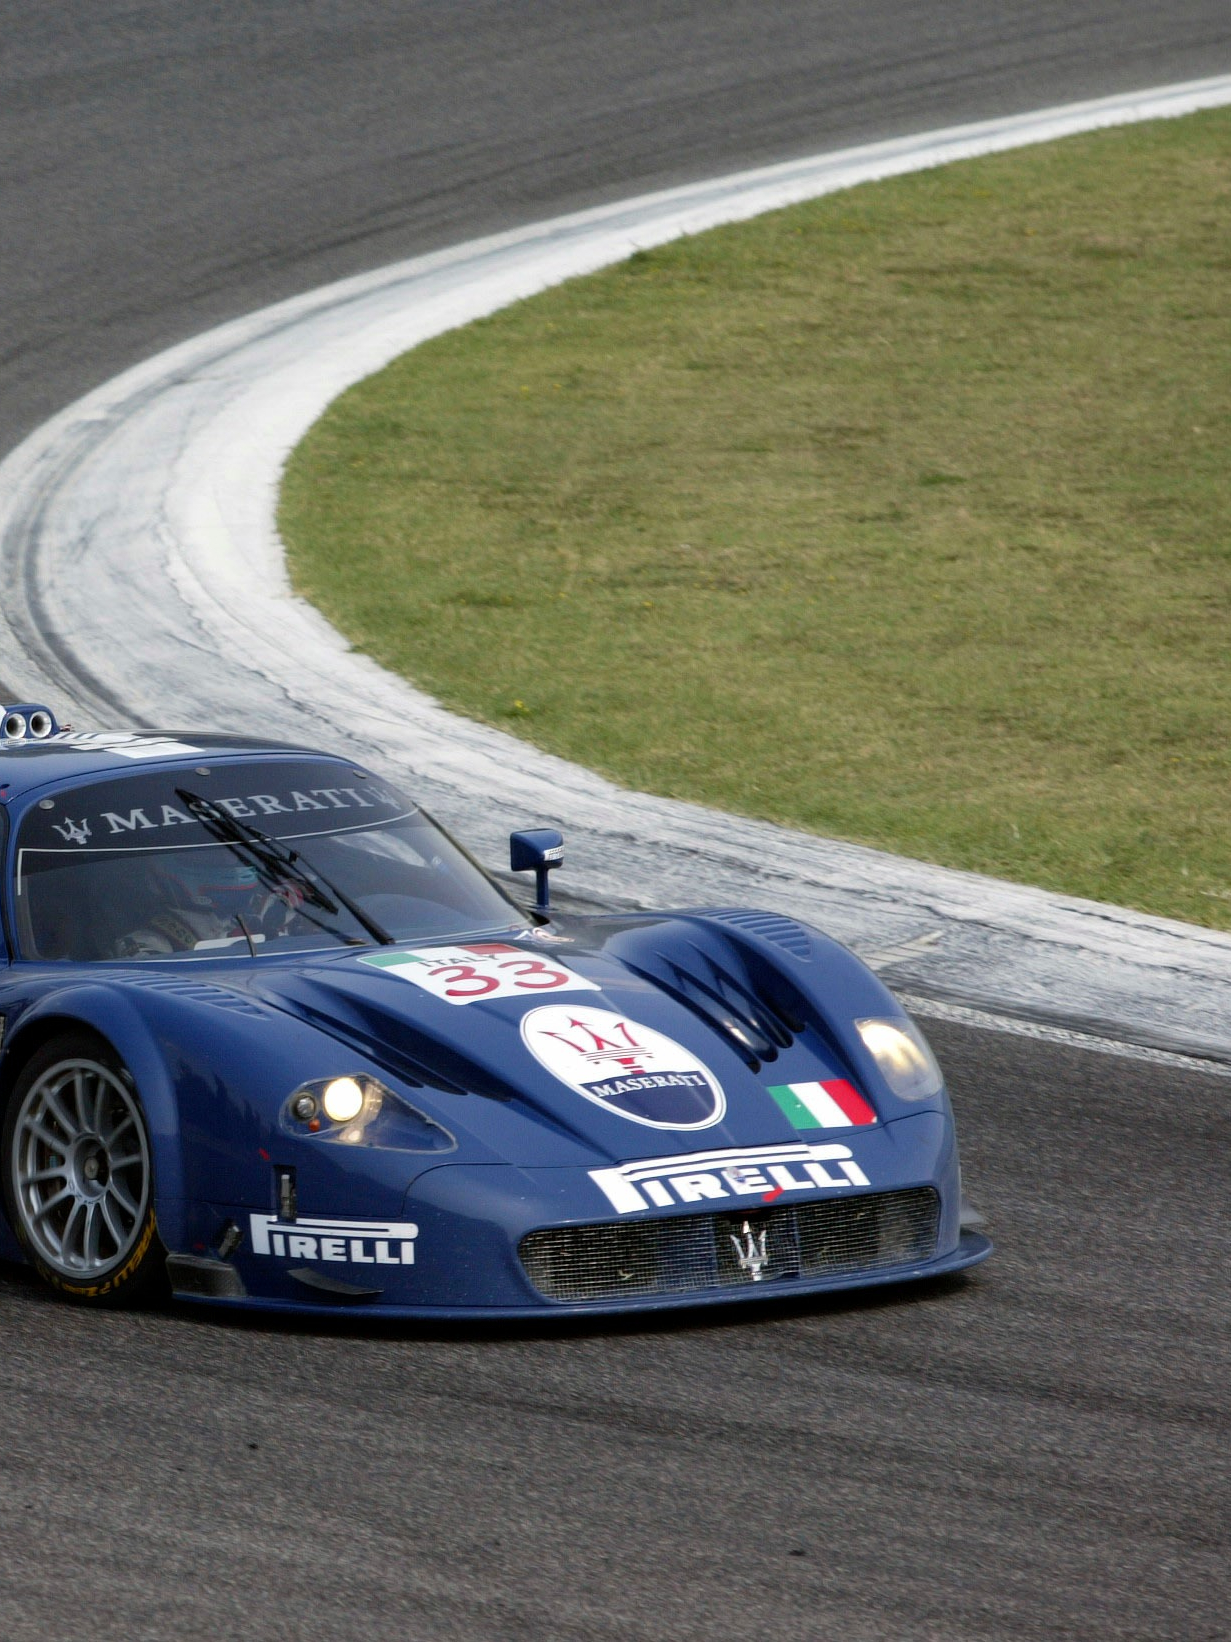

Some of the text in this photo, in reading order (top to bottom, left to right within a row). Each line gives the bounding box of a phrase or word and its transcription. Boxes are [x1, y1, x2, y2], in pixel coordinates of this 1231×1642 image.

[100, 787, 374, 834] MASERATI
[417, 952, 501, 968] ITALY
[428, 958, 570, 997] 33
[590, 1072, 707, 1099] MASERATI
[587, 1143, 872, 1215] PIRELLI
[249, 1212, 419, 1265] PIRELLI
